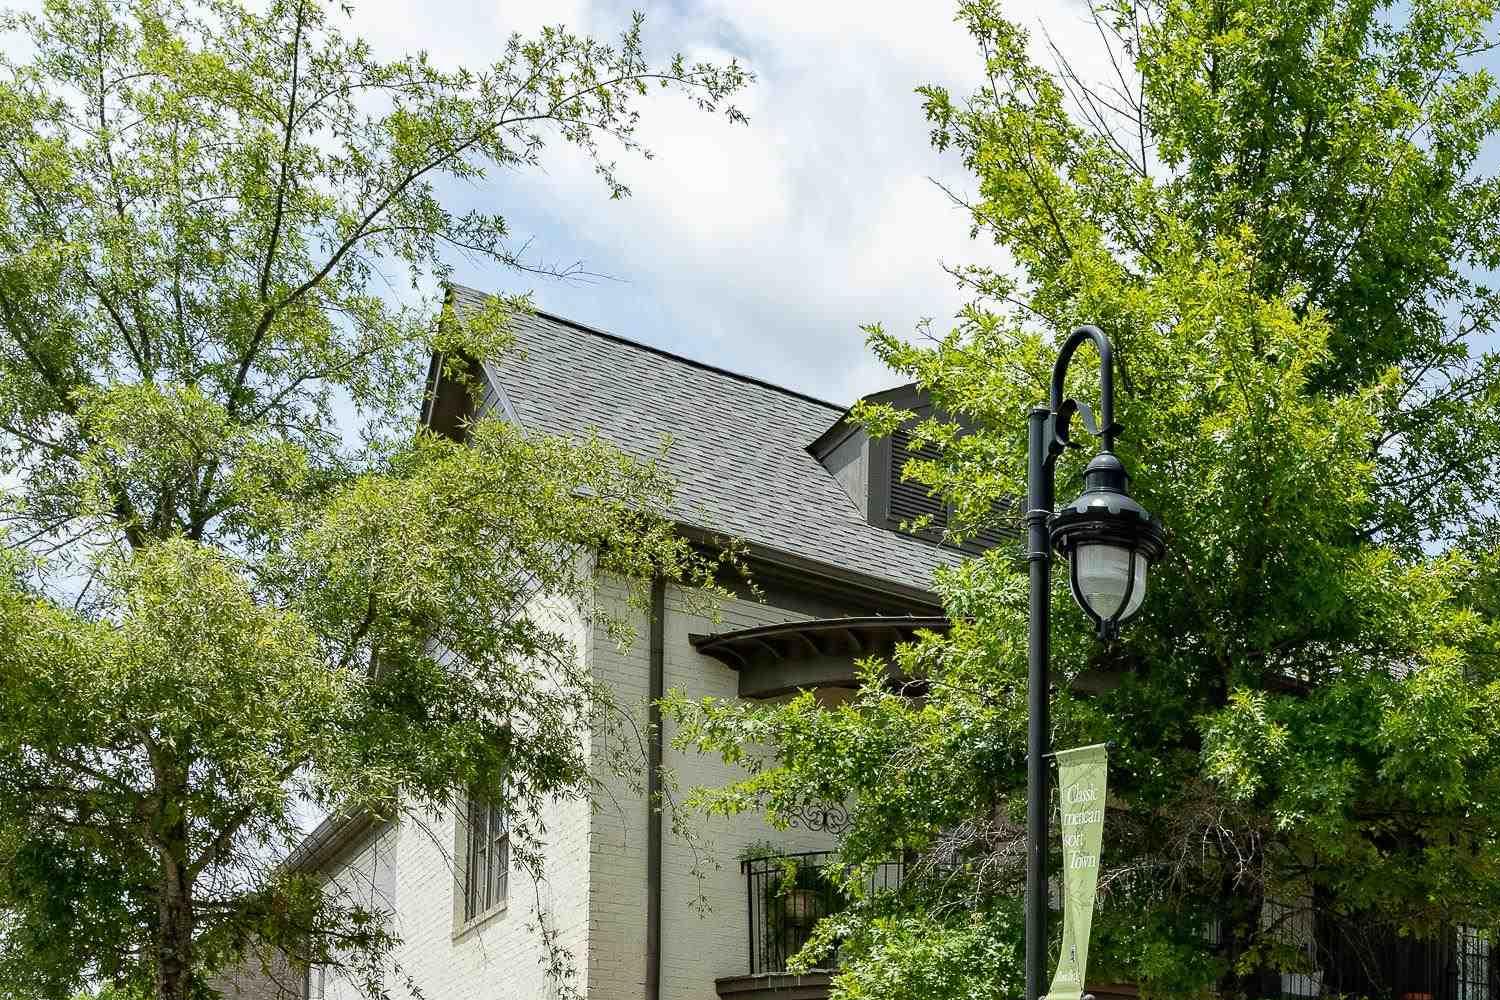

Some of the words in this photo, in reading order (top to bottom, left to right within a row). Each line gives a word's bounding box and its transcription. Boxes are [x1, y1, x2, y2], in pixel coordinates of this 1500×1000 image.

[1067, 783, 1097, 804] Classic
[1063, 809, 1101, 826] merican
[1067, 850, 1096, 869] Town
